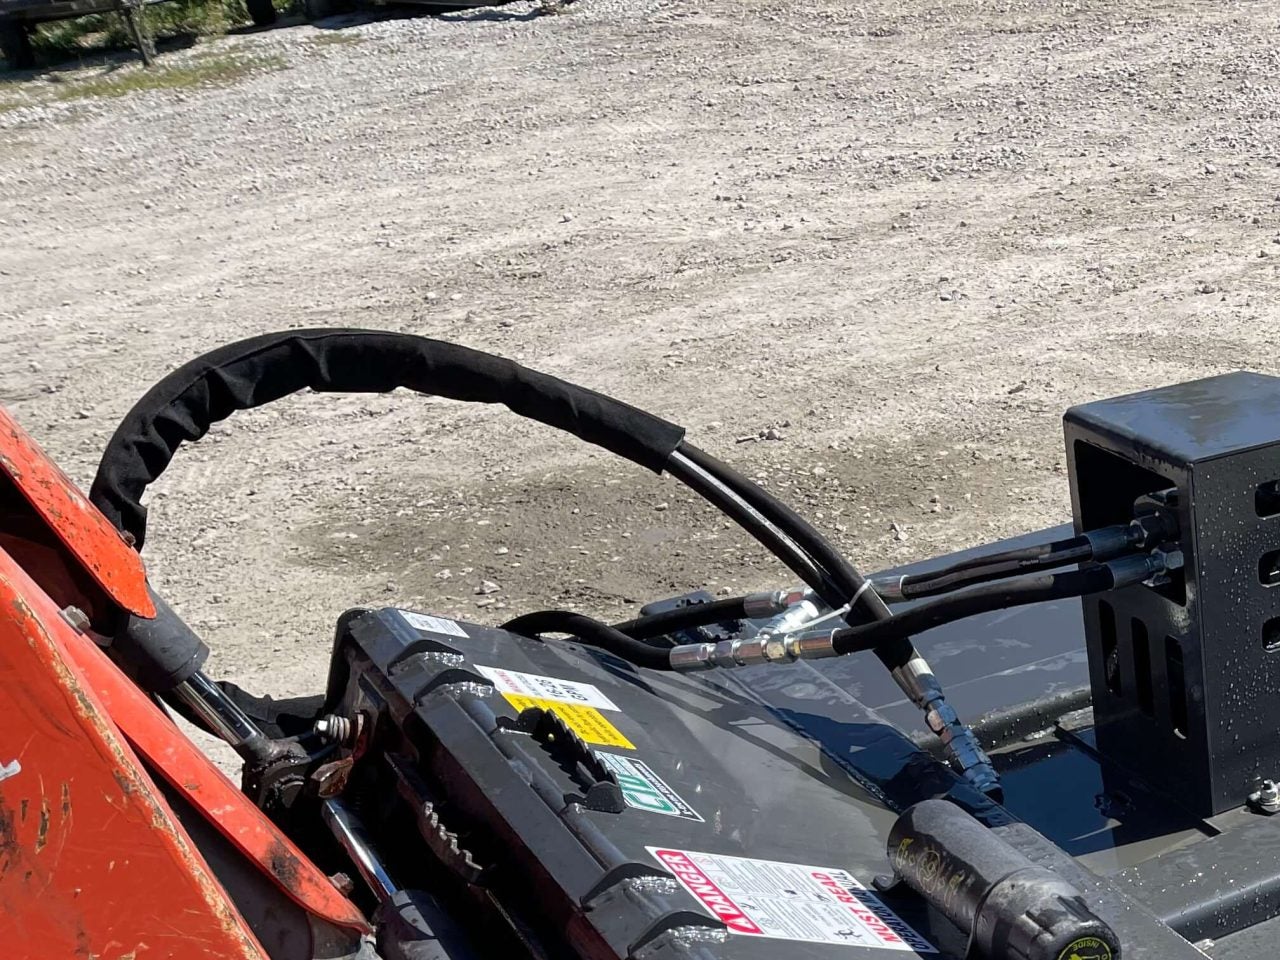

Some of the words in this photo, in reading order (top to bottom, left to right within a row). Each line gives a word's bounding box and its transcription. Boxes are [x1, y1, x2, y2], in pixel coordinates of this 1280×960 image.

[661, 853, 740, 914] DANGER
[811, 872, 858, 904] READ
[849, 906, 902, 943] MUST
[1072, 940, 1100, 951] INSIDE
